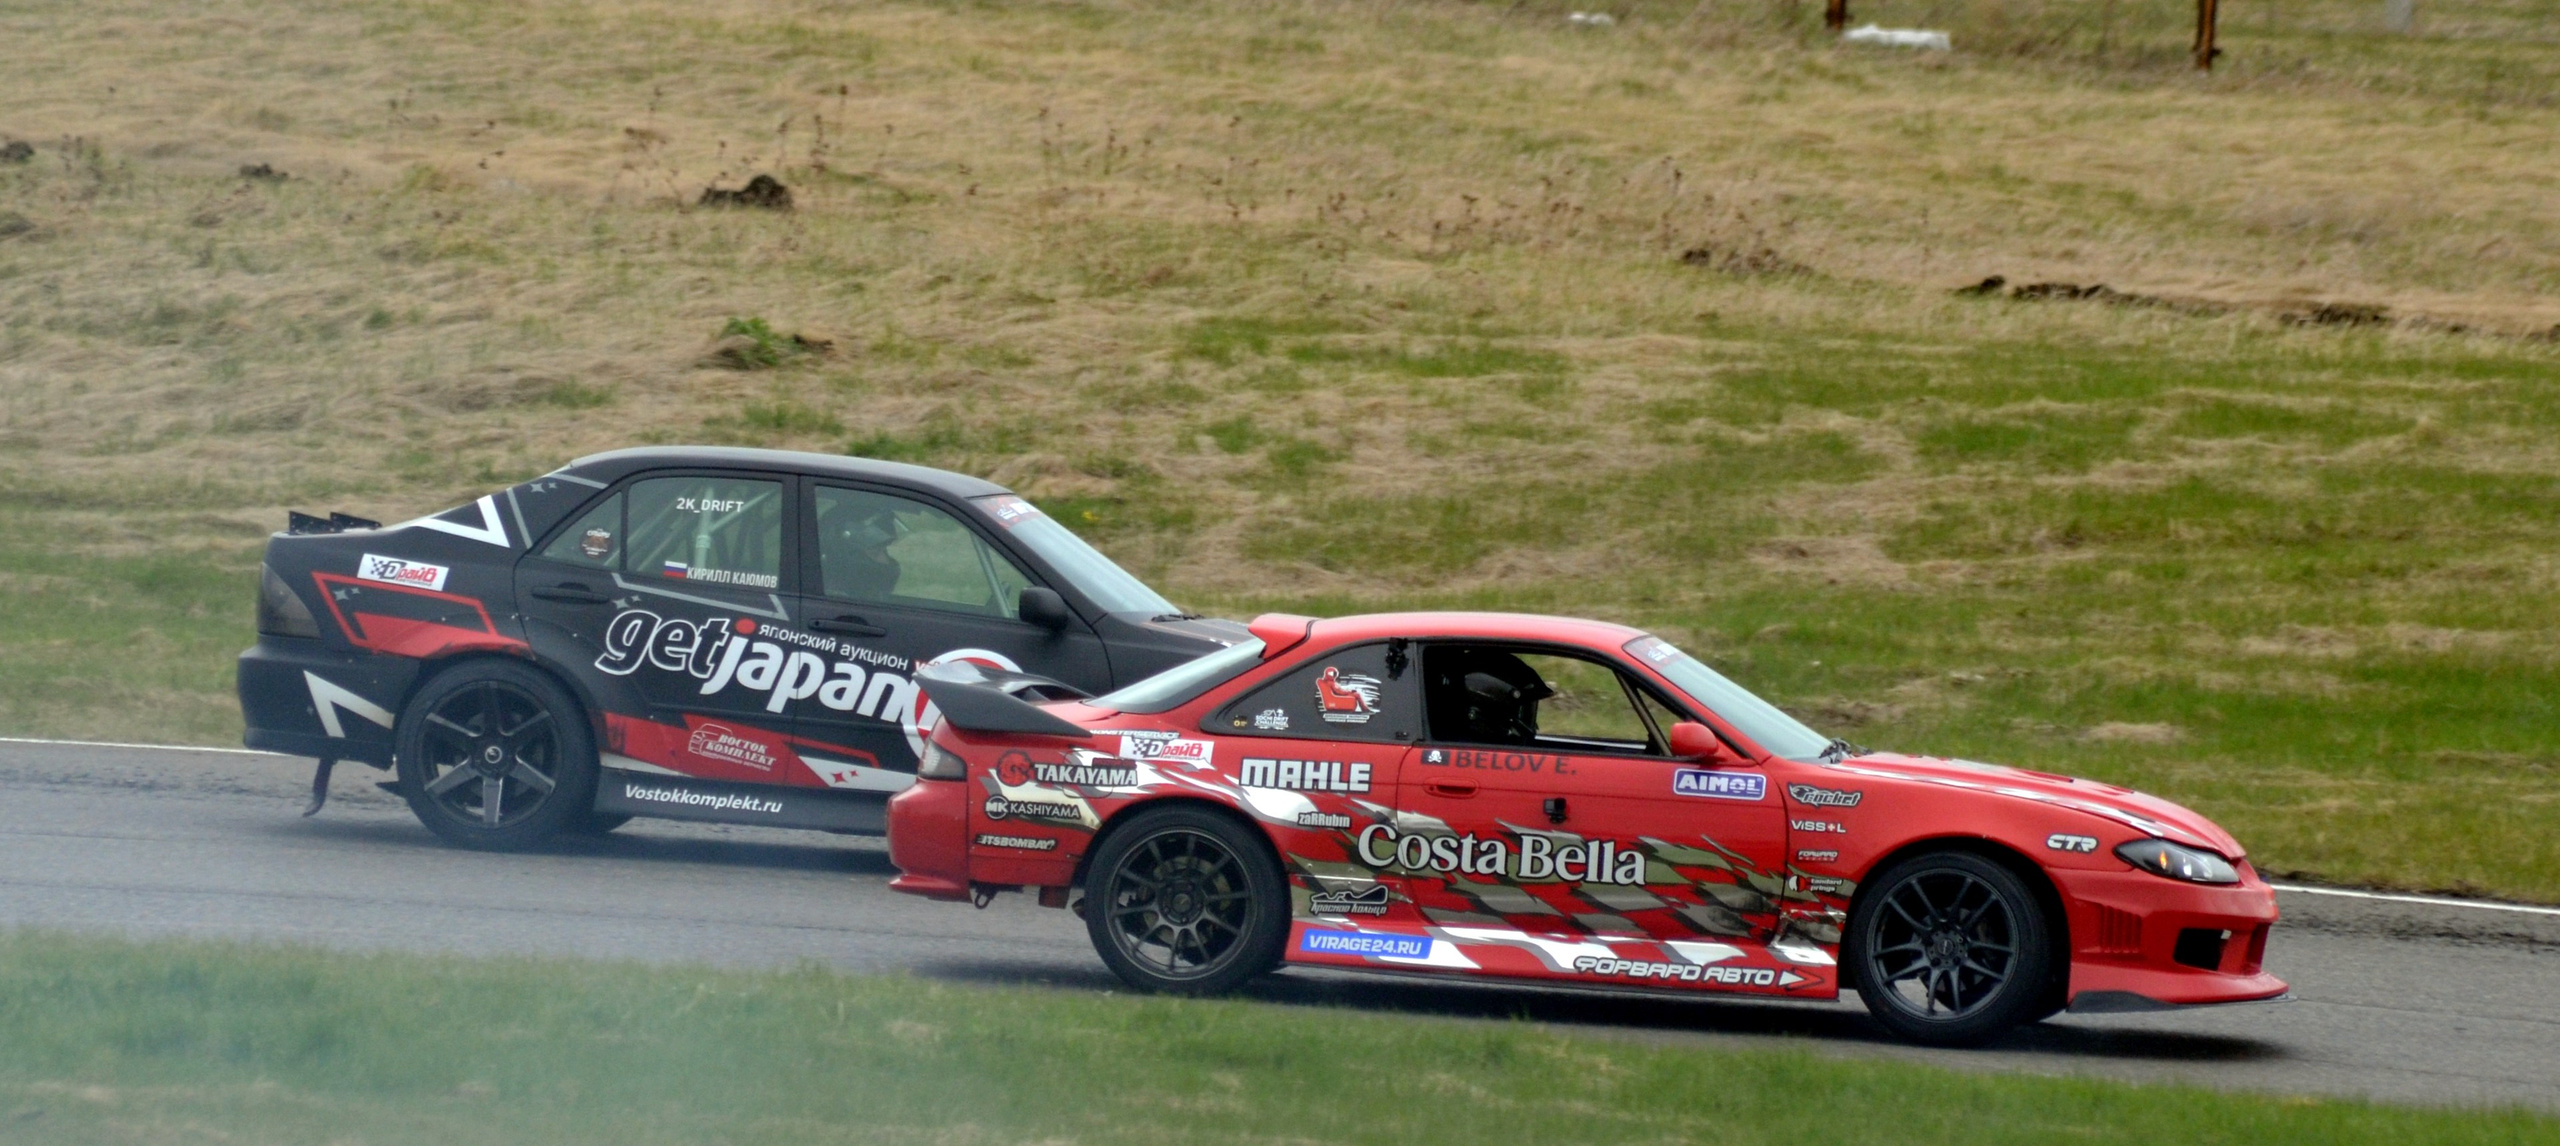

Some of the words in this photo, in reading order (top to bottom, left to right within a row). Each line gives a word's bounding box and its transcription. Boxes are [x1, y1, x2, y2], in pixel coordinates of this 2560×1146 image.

[675, 497, 744, 513] 2K_DRIFT
[686, 567, 731, 584] КИРИЛЛ
[732, 572, 778, 588] КАЮМОВ
[840, 643, 909, 671] аукцион
[705, 741, 777, 766] КОМПЛЕКТ
[718, 734, 768, 754] ВОСТОК
[1034, 763, 1138, 785] TAKAYAMA
[1455, 751, 1547, 772] BELOV
[1555, 757, 1577, 775] E.
[1240, 758, 1371, 792] MAHLE
[1678, 774, 1761, 794] AIMOL
[625, 784, 783, 813] Vostokkomplekt.ru
[985, 801, 1009, 813] MK
[1010, 801, 1080, 818] KASHIYAMA
[2047, 834, 2097, 852] CTR
[1358, 823, 1507, 875] Costa
[1518, 835, 1646, 886] Bella
